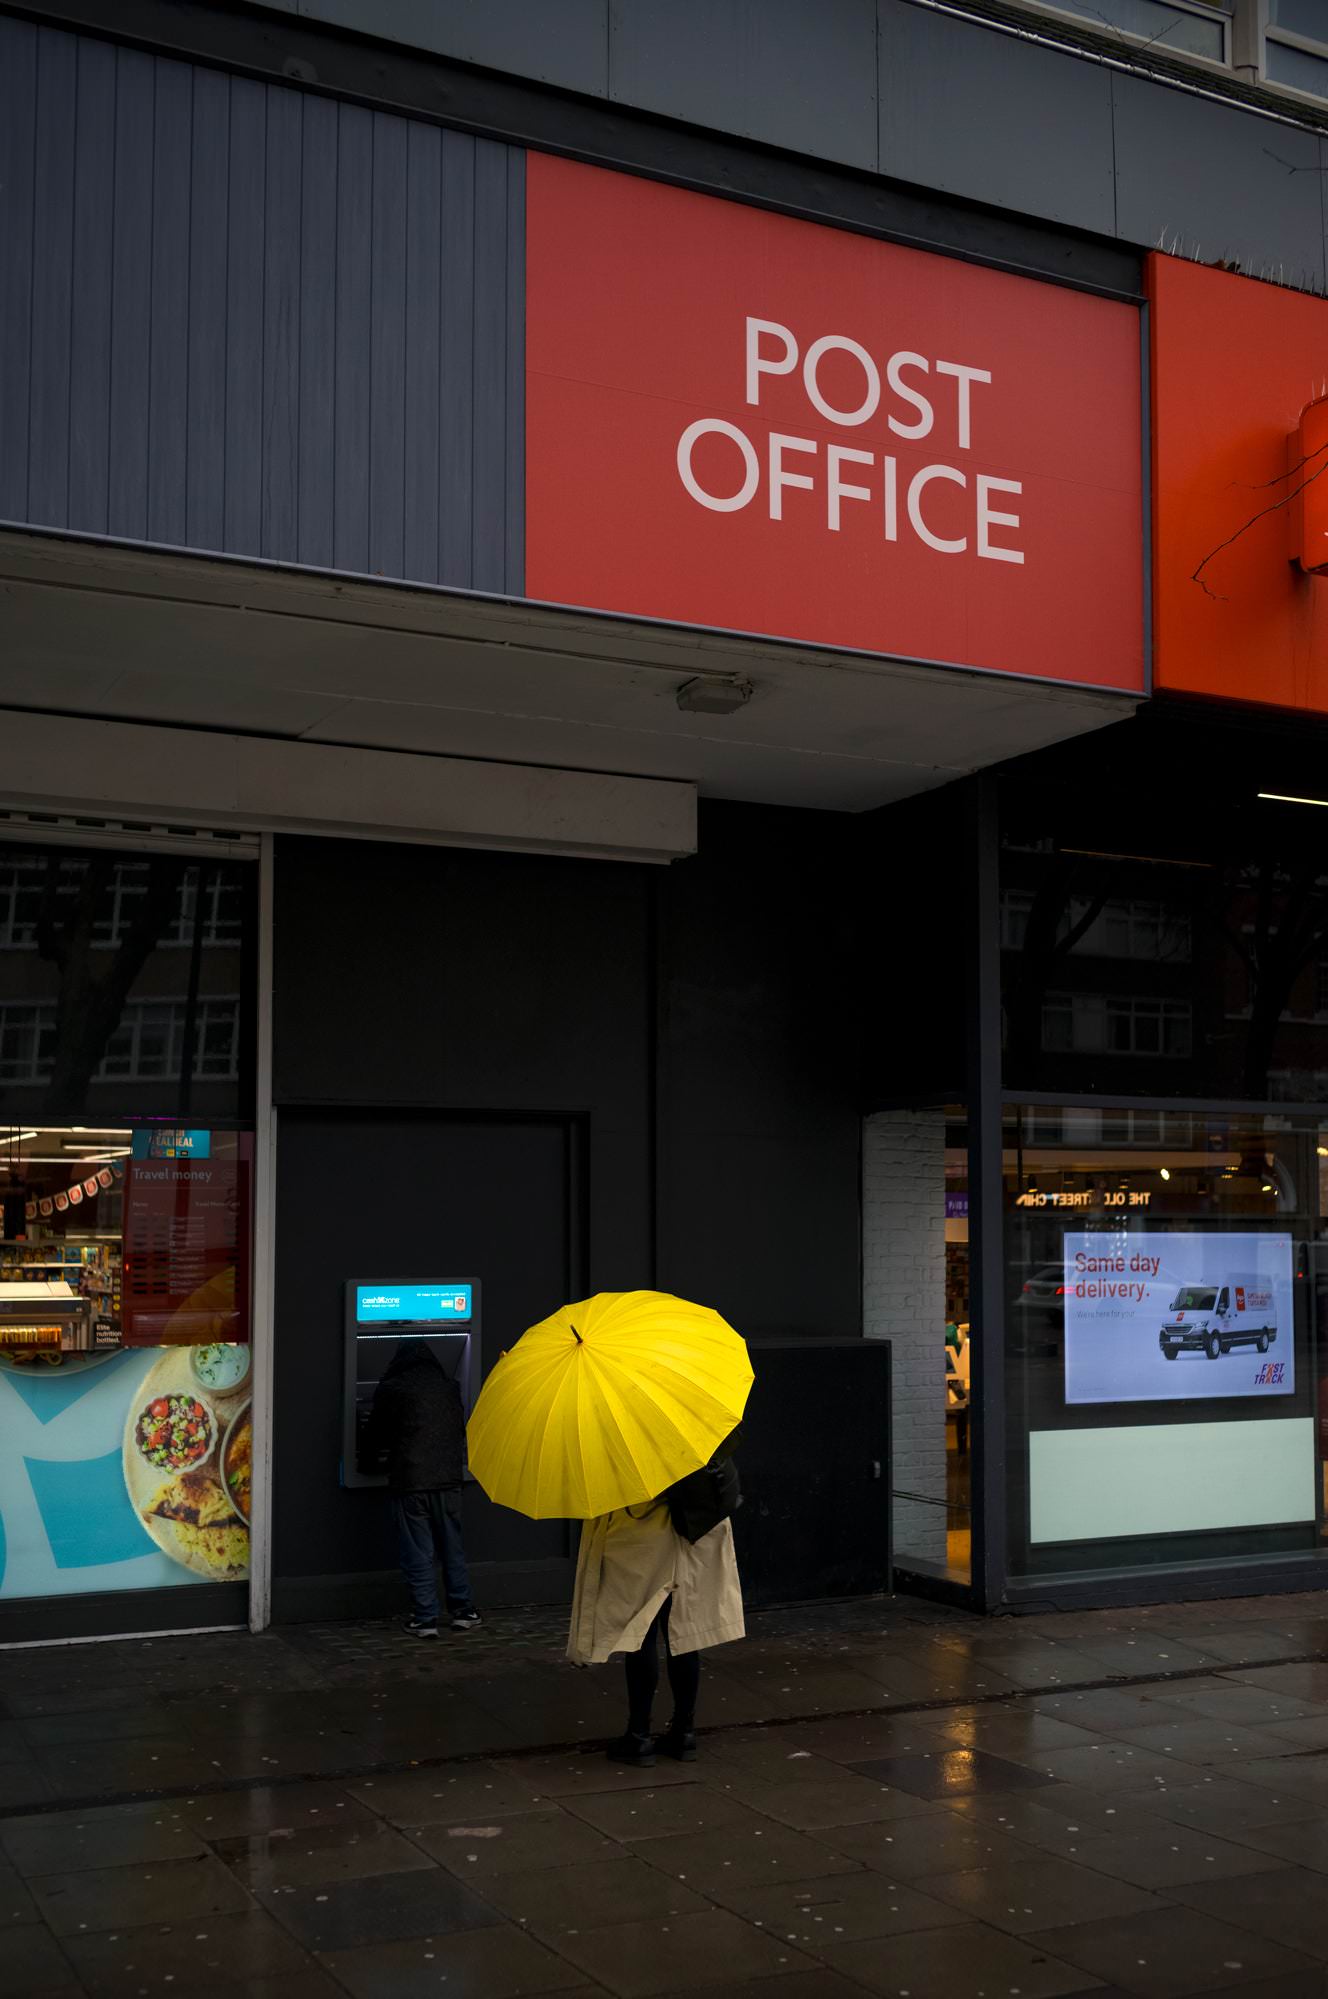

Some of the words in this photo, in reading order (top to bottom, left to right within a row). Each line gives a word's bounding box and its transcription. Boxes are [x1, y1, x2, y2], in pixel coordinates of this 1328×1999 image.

[746, 317, 992, 449] POST
[677, 418, 1025, 564] OFFICE
[132, 1168, 169, 1180] Travel
[172, 1170, 212, 1183] money
[1074, 1252, 1126, 1273] Same
[1130, 1253, 1161, 1277] day
[1075, 1279, 1151, 1303] delivery.
